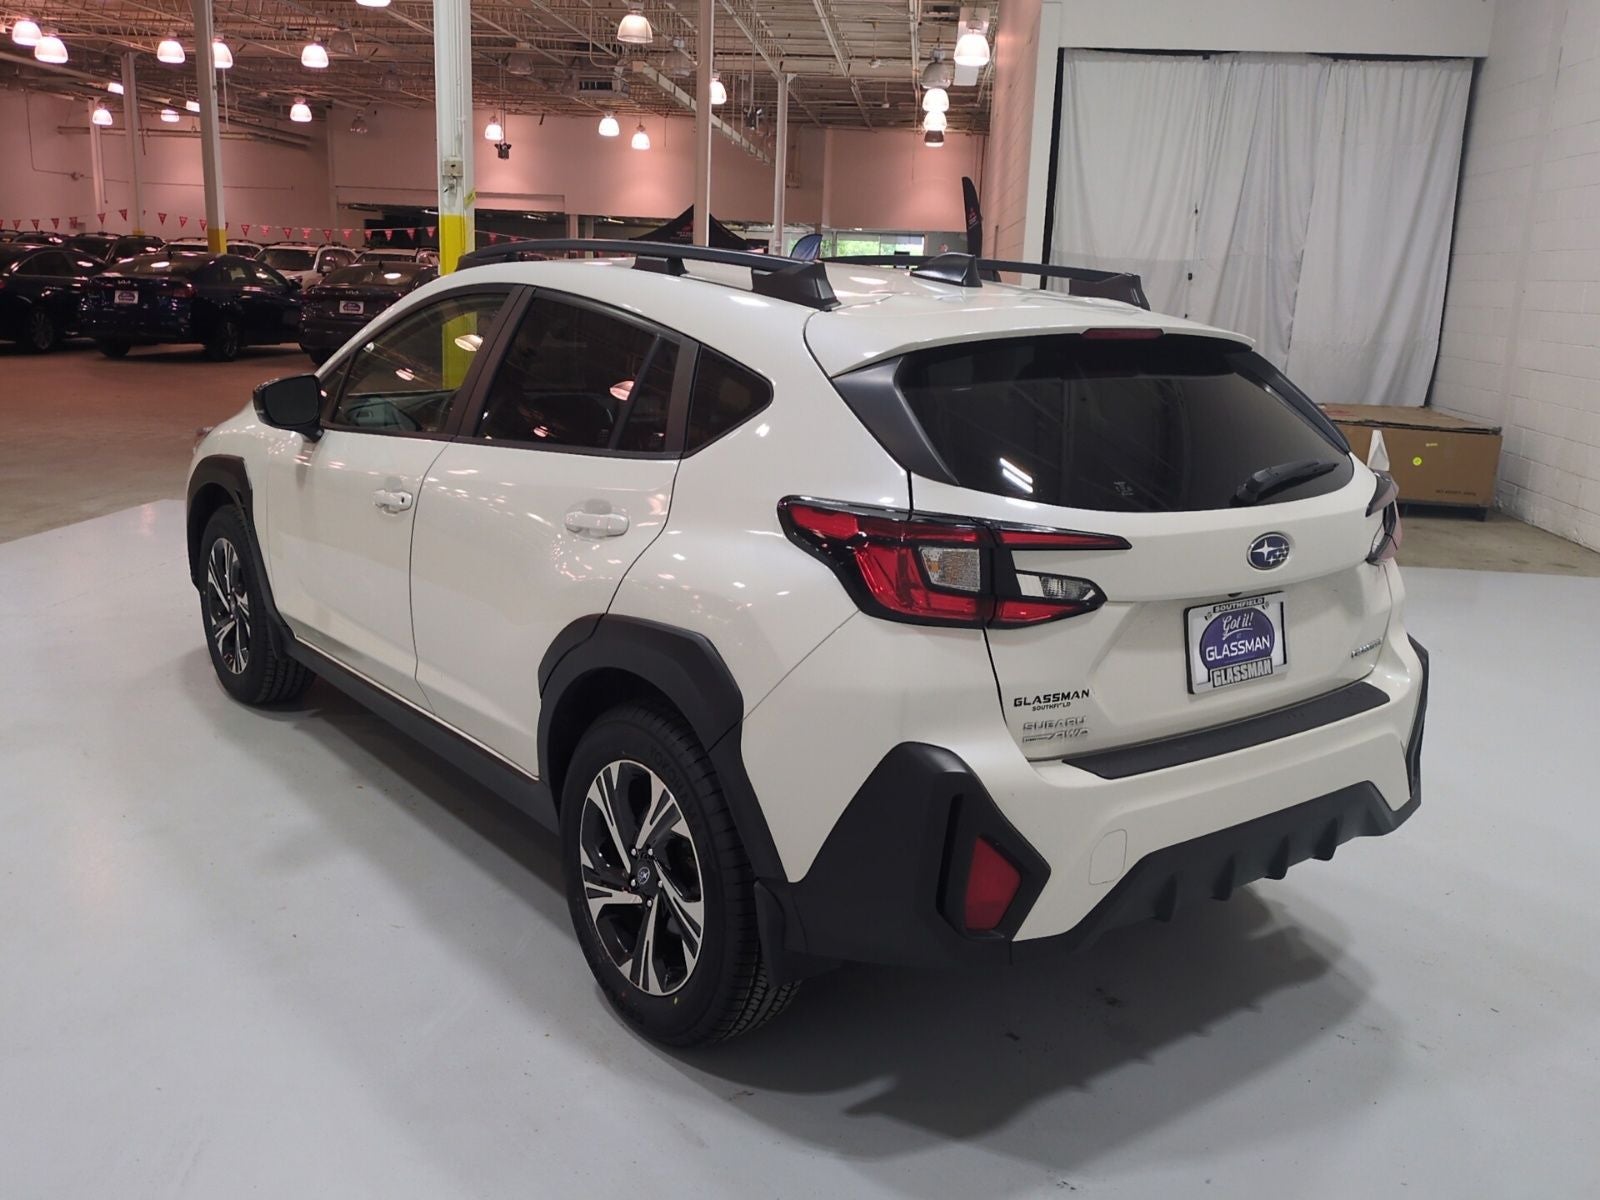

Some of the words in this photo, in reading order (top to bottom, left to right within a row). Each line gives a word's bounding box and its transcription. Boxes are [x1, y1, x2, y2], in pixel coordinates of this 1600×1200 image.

[1213, 597, 1265, 613] SOUTHFIELD
[1222, 614, 1241, 633] Got
[1242, 611, 1254, 627] it!
[1205, 635, 1271, 662] GLASSMAN
[1213, 659, 1273, 687] GLASSMAN
[1013, 689, 1090, 707] GLASSMAN
[1023, 716, 1085, 730] SUBARU
